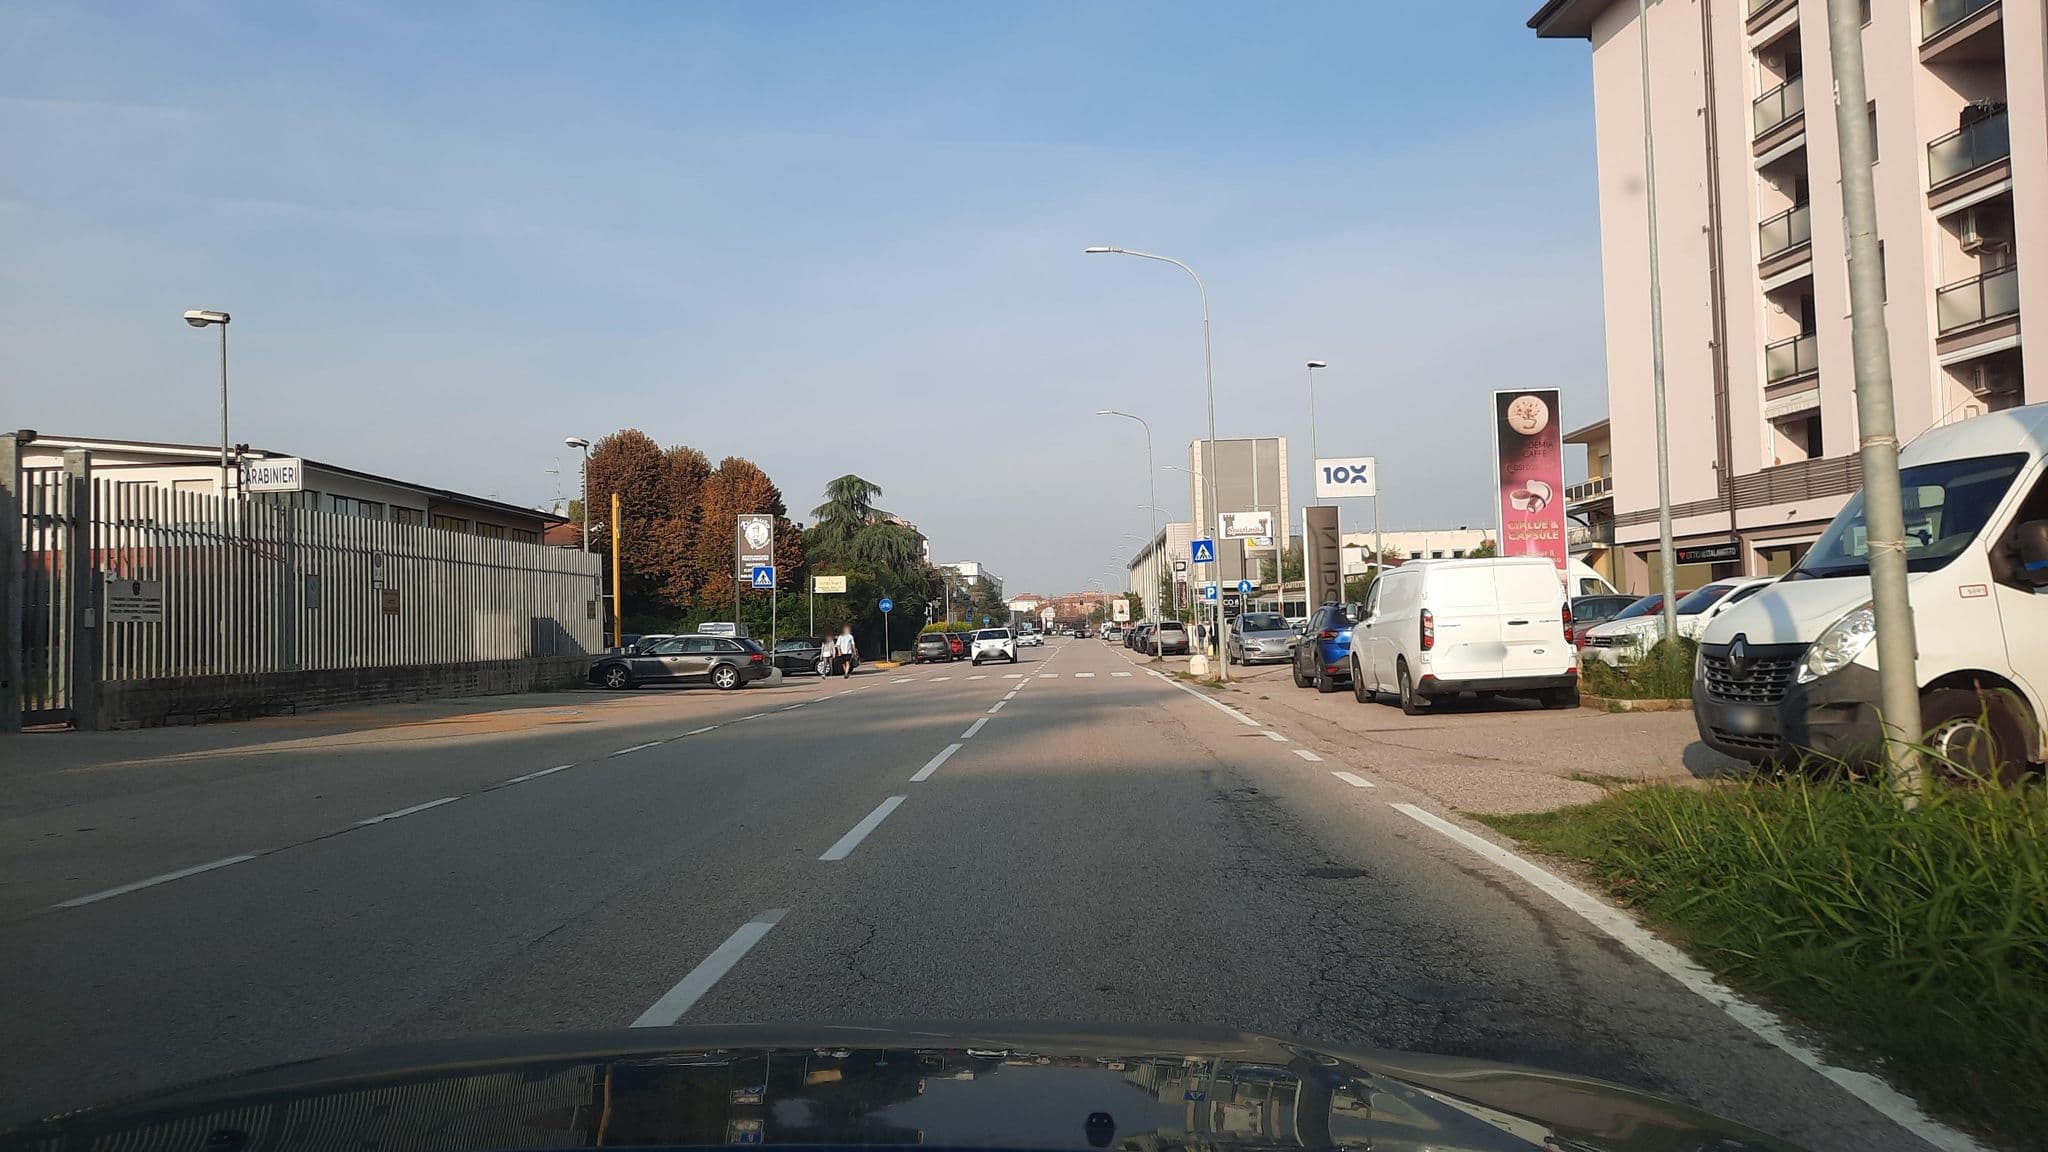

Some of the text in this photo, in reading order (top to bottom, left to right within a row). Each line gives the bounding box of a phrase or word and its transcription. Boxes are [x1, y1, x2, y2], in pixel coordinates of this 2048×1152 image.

[240, 467, 297, 485] CARABINIERI
[1323, 465, 1367, 484] 10X
[1508, 531, 1559, 541] CAPSULE
[1207, 588, 1215, 598] P
